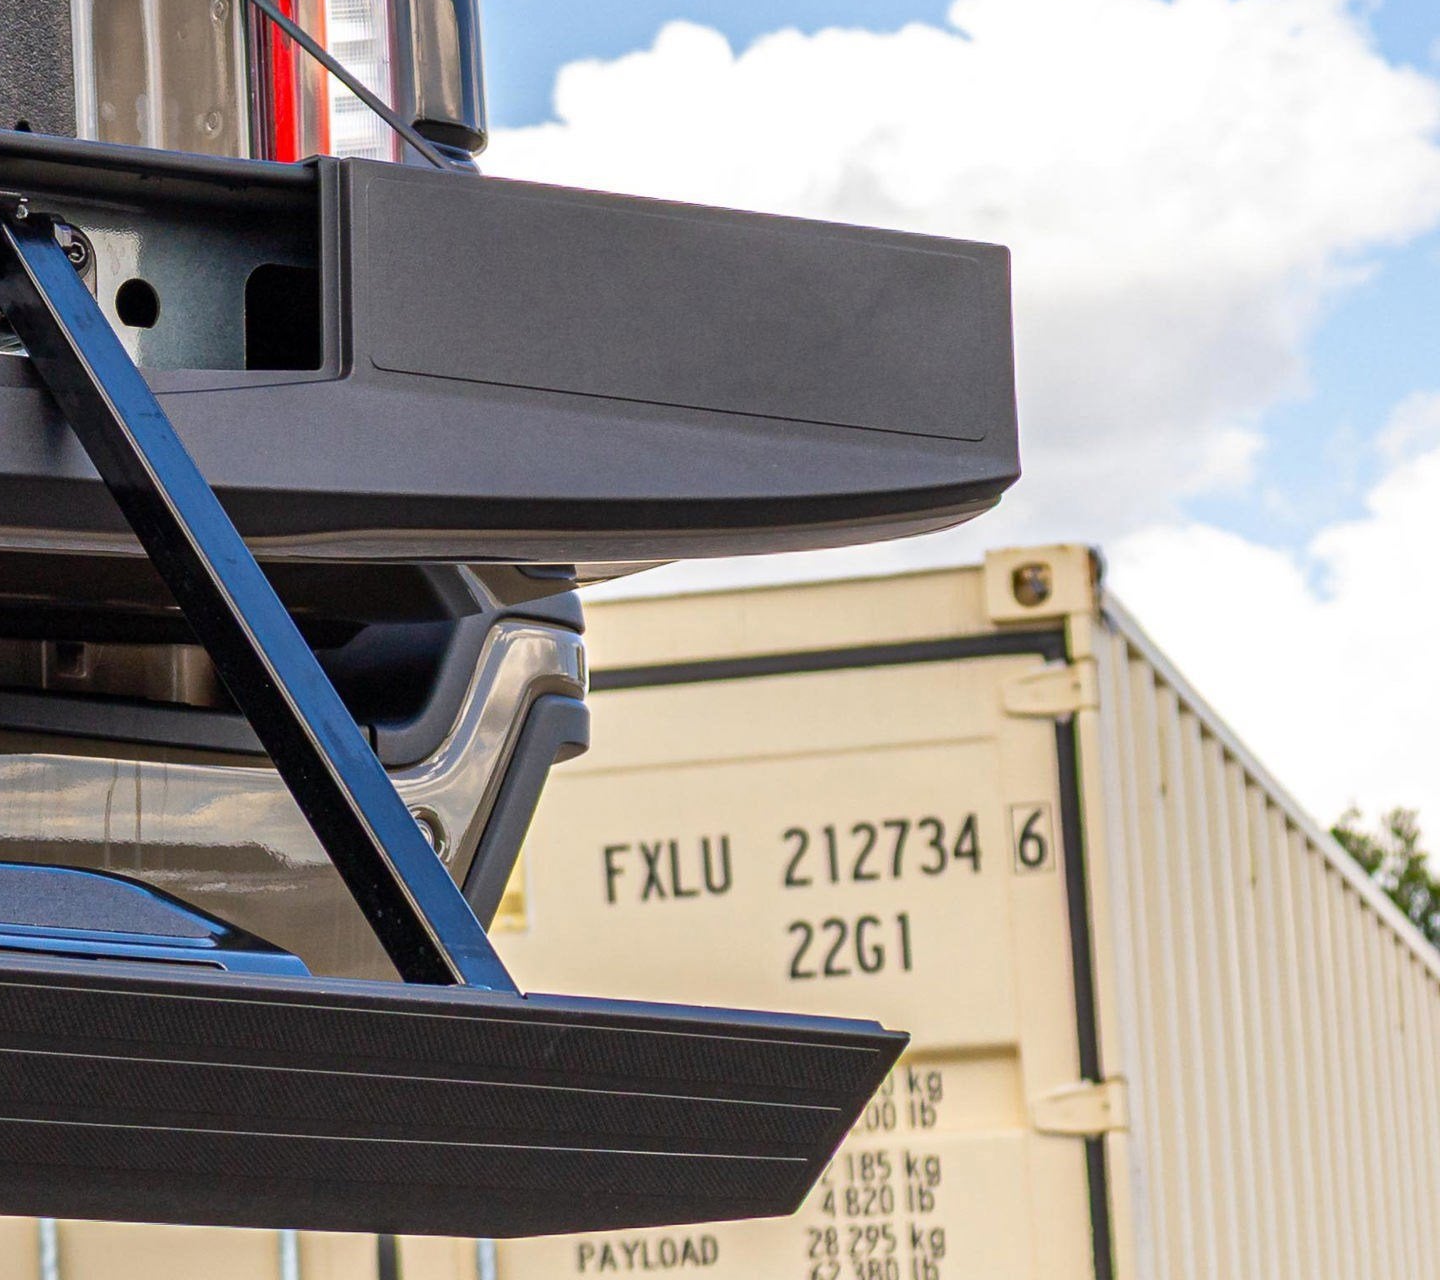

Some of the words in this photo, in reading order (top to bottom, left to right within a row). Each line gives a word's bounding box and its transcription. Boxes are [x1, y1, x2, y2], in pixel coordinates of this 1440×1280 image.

[602, 833, 733, 904] FXLU
[782, 812, 982, 888] 212734
[1017, 808, 1048, 868] 6
[787, 912, 913, 980] 22G1
[906, 1065, 944, 1102] kg
[853, 1101, 897, 1134] 00
[908, 1099, 937, 1129] lb
[845, 1151, 892, 1185] 185
[904, 1149, 942, 1187] kg
[905, 1184, 936, 1214] lb
[577, 1234, 719, 1274] PAYLOAD
[909, 1223, 946, 1260] kg
